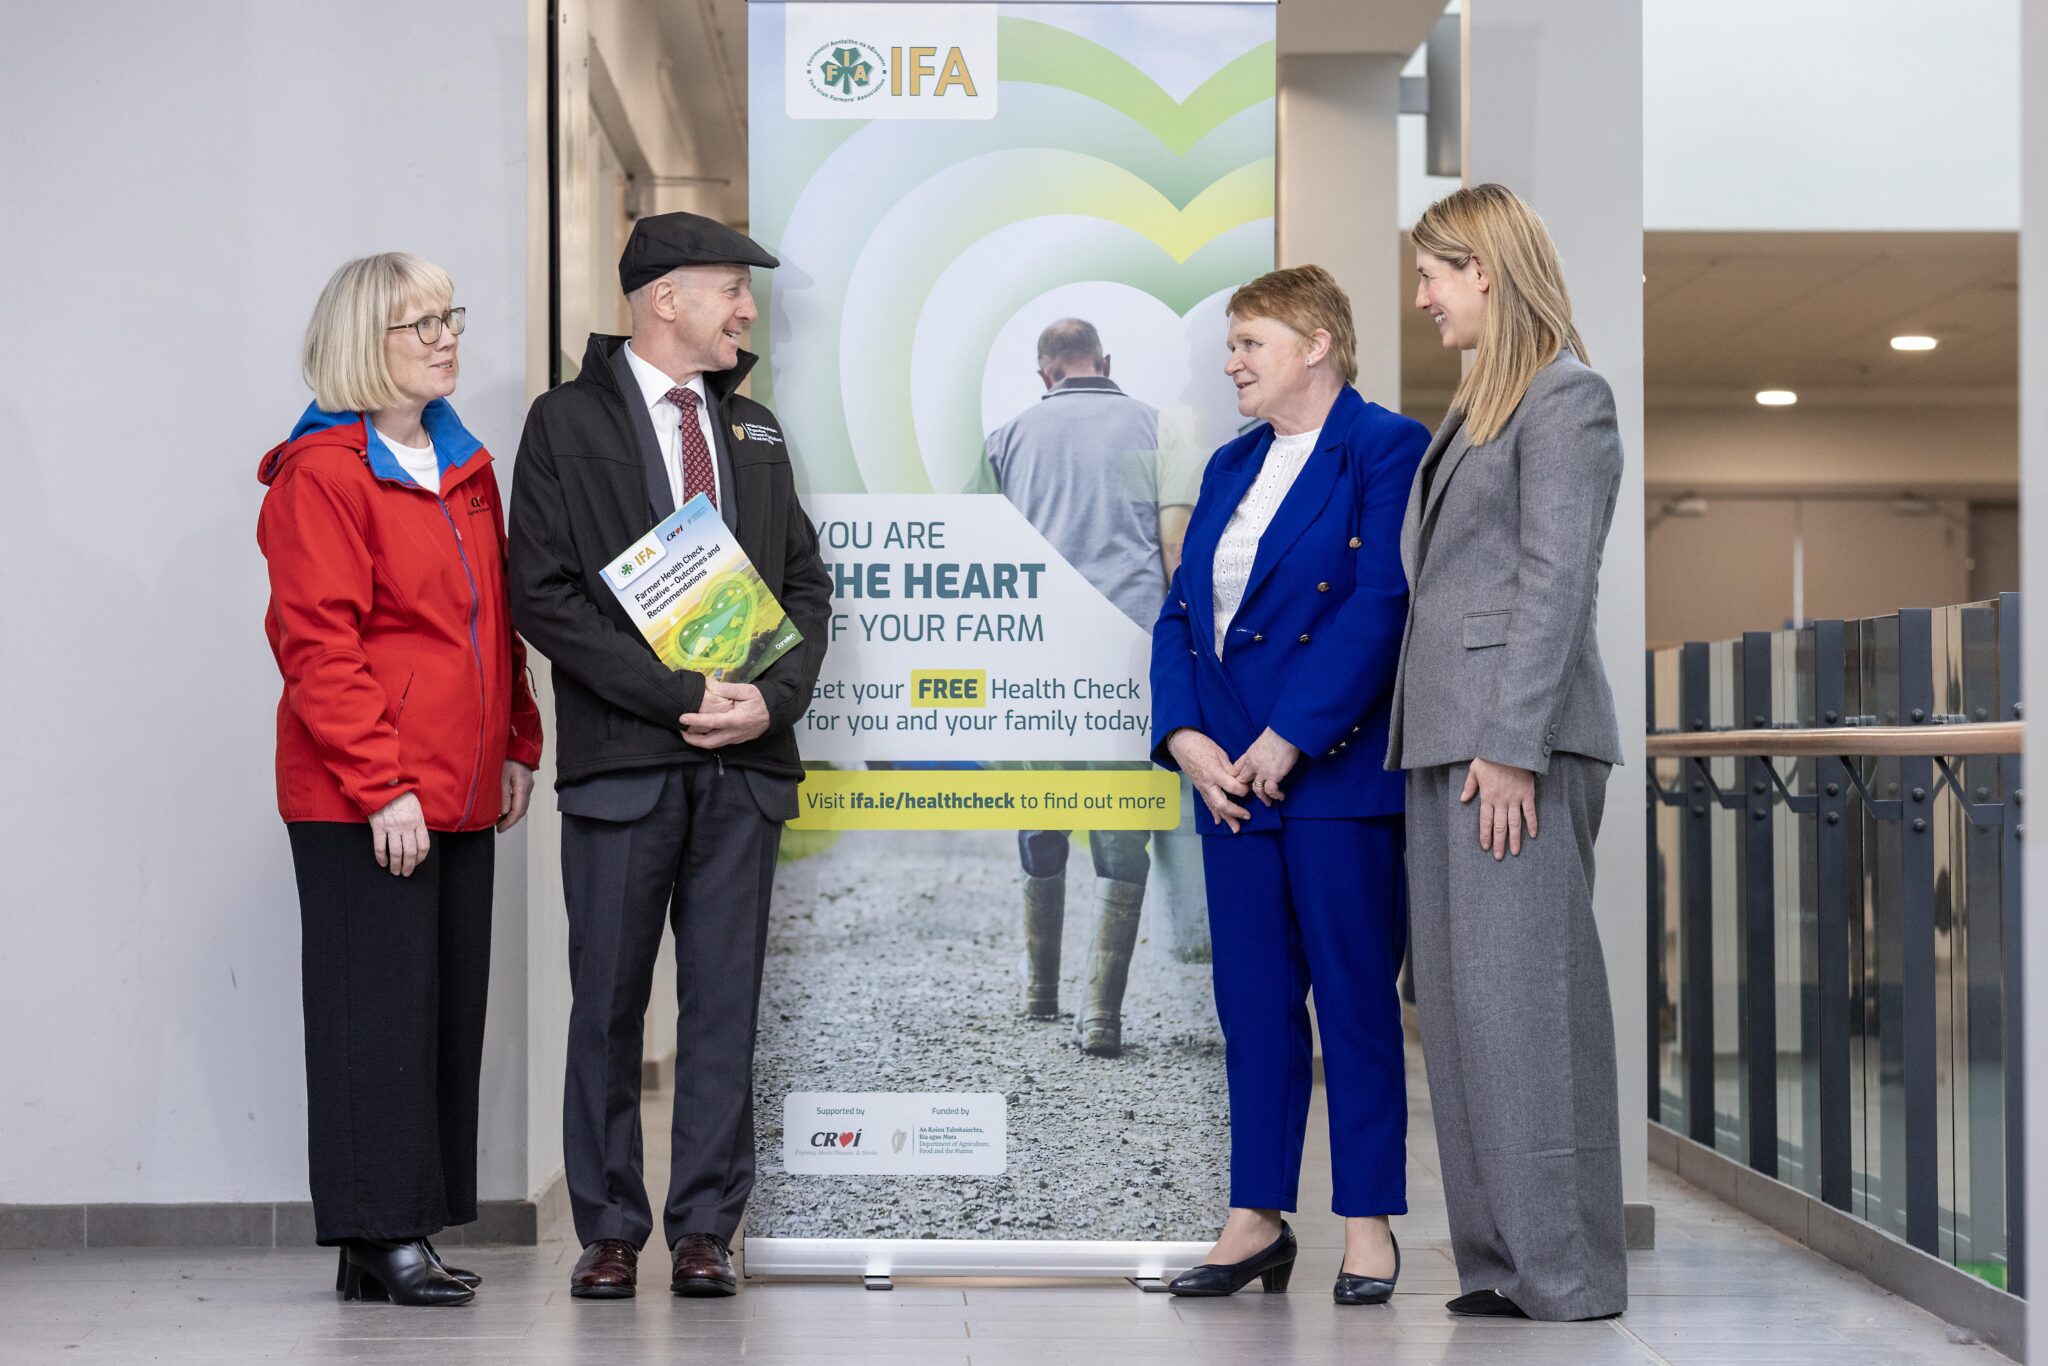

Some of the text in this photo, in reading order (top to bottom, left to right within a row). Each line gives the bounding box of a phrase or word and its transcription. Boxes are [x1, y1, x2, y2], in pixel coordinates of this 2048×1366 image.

[891, 46, 978, 96] IFA
[816, 88, 828, 98] Irish
[857, 79, 886, 101] Association
[884, 522, 945, 548] ARE
[634, 546, 656, 566] IFA
[635, 544, 704, 602] Farmer Health Check
[641, 587, 670, 610] Initiative
[674, 556, 707, 584] Outcomes
[707, 544, 720, 558] and
[824, 563, 1046, 598] HE HEART
[646, 569, 707, 619] Recommendations
[832, 614, 1044, 642] F YOUR FARM
[852, 683, 904, 705] your
[918, 678, 978, 699] FREE
[992, 678, 1065, 699] Health
[1074, 678, 1140, 699] Check
[806, 710, 840, 730] for
[847, 714, 888, 736] you
[896, 710, 937, 730] and
[946, 714, 997, 736] your
[1005, 710, 1077, 736] family
[806, 792, 1166, 810] Visit ifa.ie/healthcheck to find out more
[817, 1107, 865, 1116] Supported by
[932, 1107, 970, 1116] Funded by
